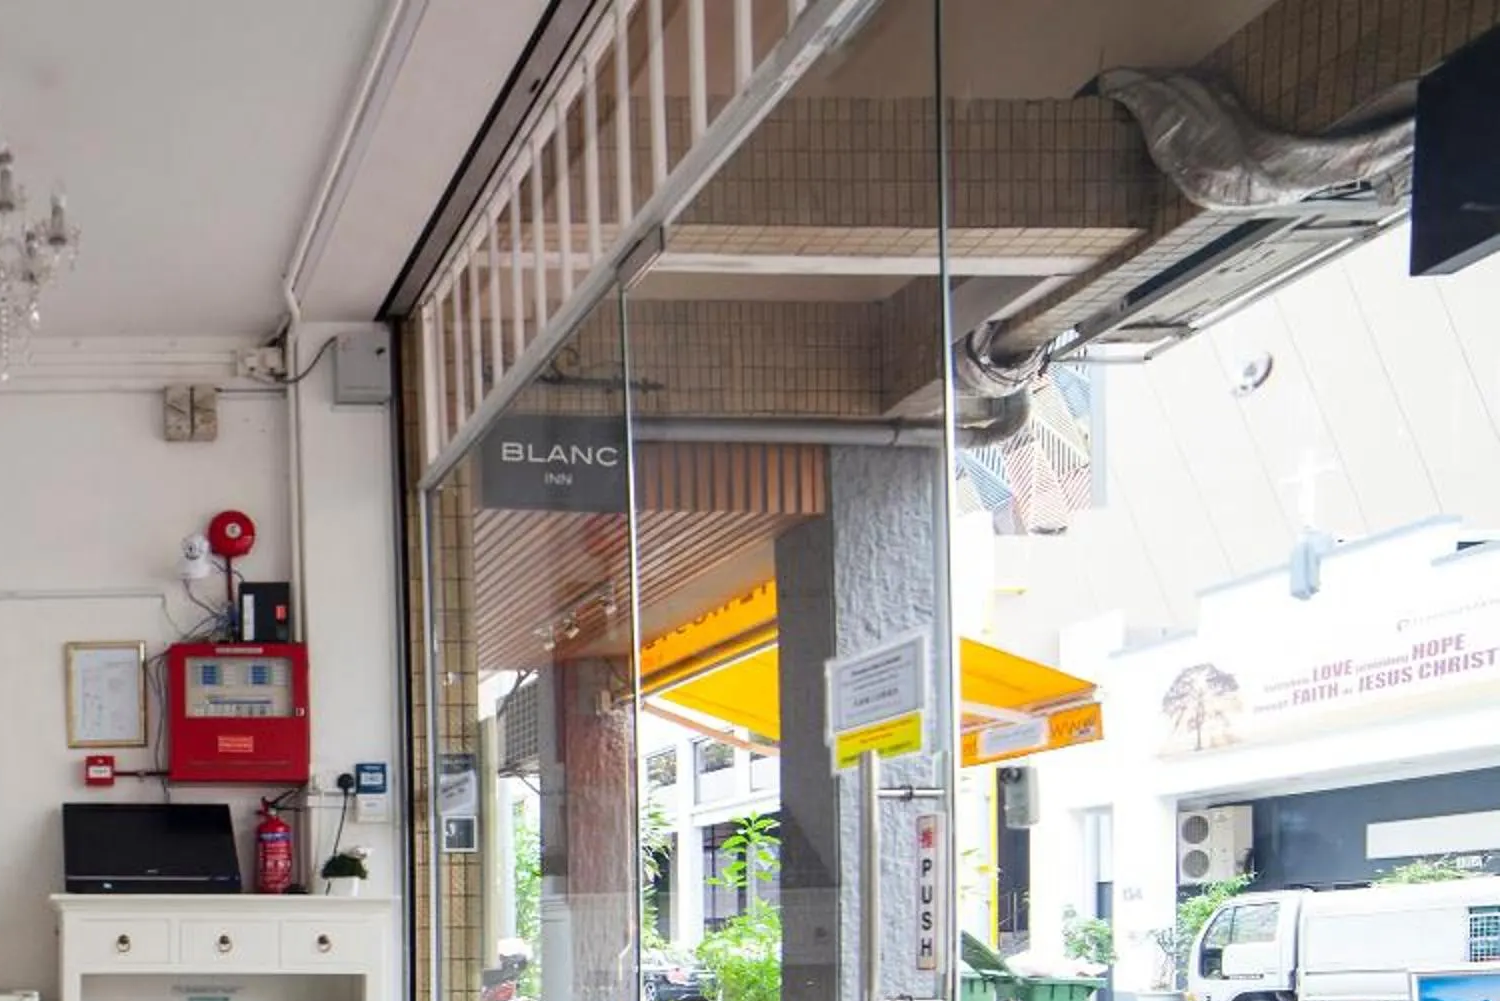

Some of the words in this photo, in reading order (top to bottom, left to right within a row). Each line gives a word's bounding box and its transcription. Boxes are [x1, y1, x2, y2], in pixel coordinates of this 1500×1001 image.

[501, 441, 619, 467] BLANC
[544, 472, 574, 486] INN
[1291, 683, 1339, 706] FAITH
[1358, 665, 1413, 693] JESUS
[1418, 647, 1500, 680] CHRIST
[1312, 659, 1353, 683] LOVE
[1411, 633, 1466, 661] HOPE
[920, 858, 933, 957] PUSH
